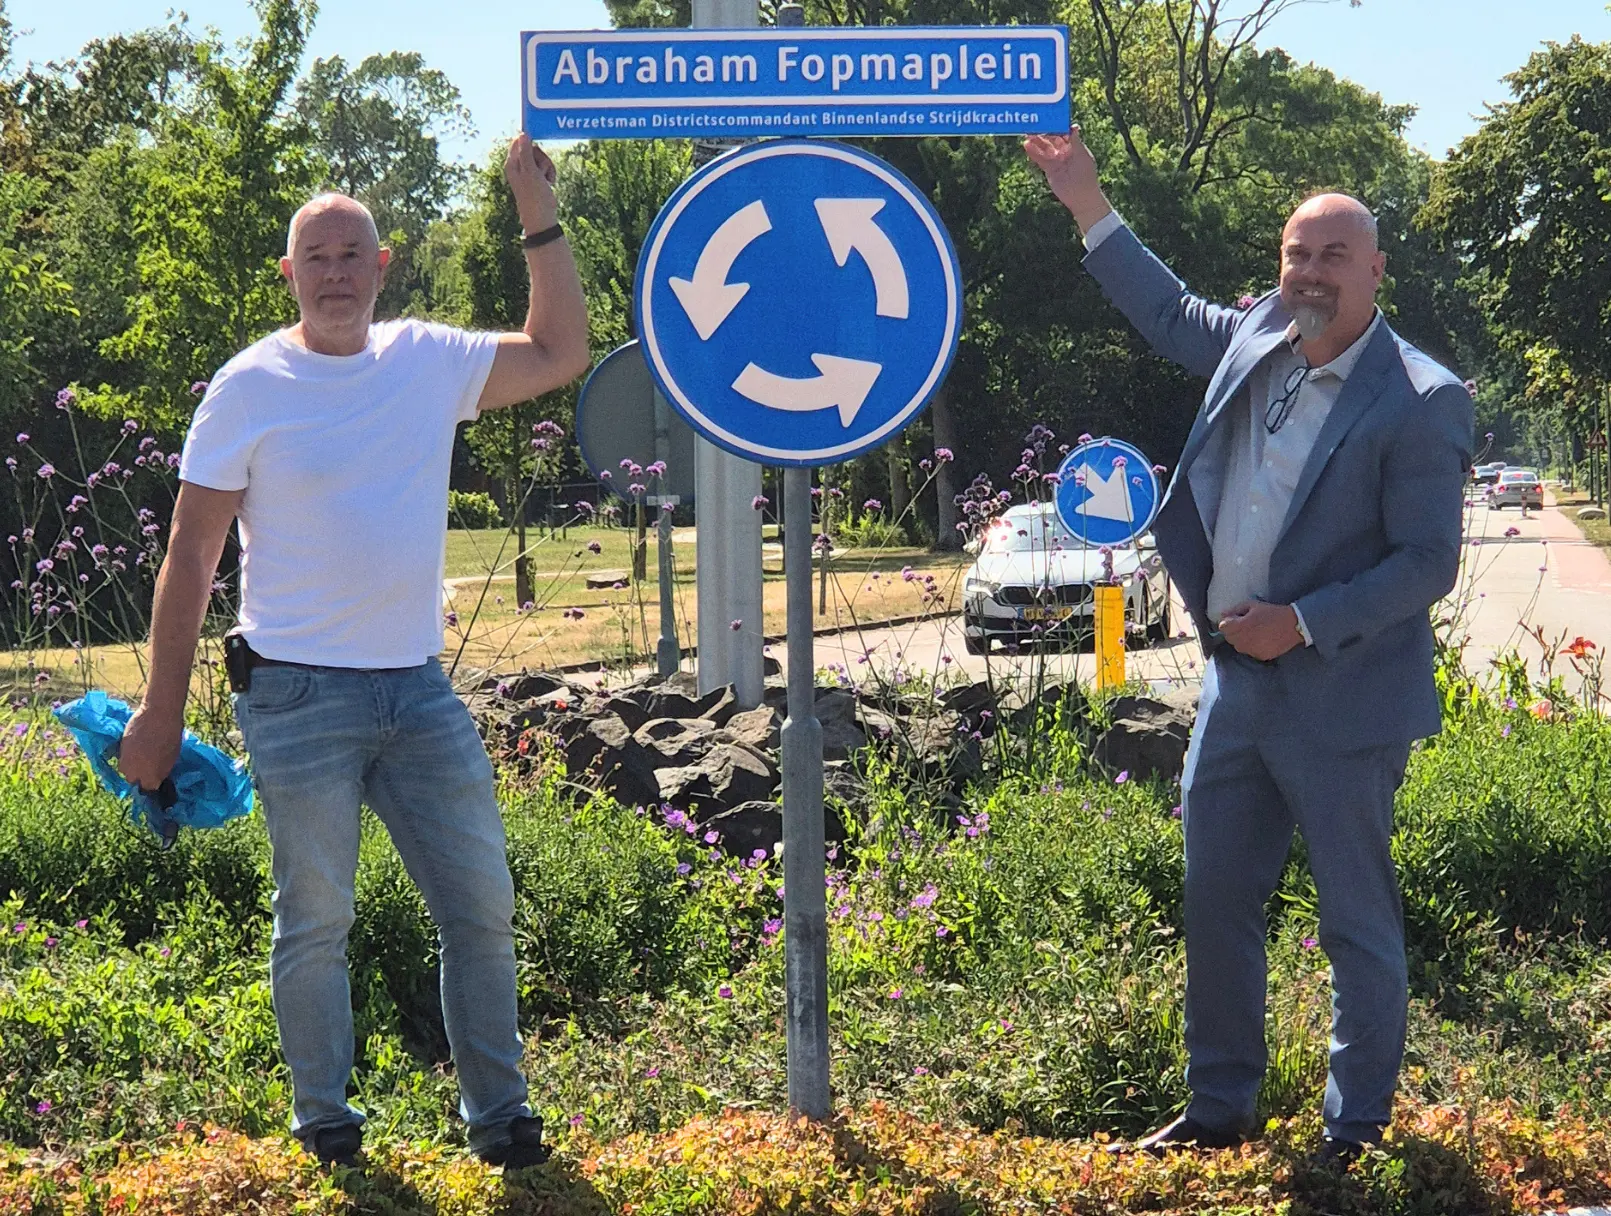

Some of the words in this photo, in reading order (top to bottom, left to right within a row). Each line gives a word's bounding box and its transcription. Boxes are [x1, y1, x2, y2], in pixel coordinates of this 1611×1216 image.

[552, 47, 758, 85] Abraham
[777, 43, 1042, 91] Fopmaplein
[556, 114, 647, 129] Verzetsman
[652, 112, 817, 128] Districtscommandant
[822, 111, 925, 125] Binnenlandse
[929, 110, 1039, 127] Strijdkrachten
